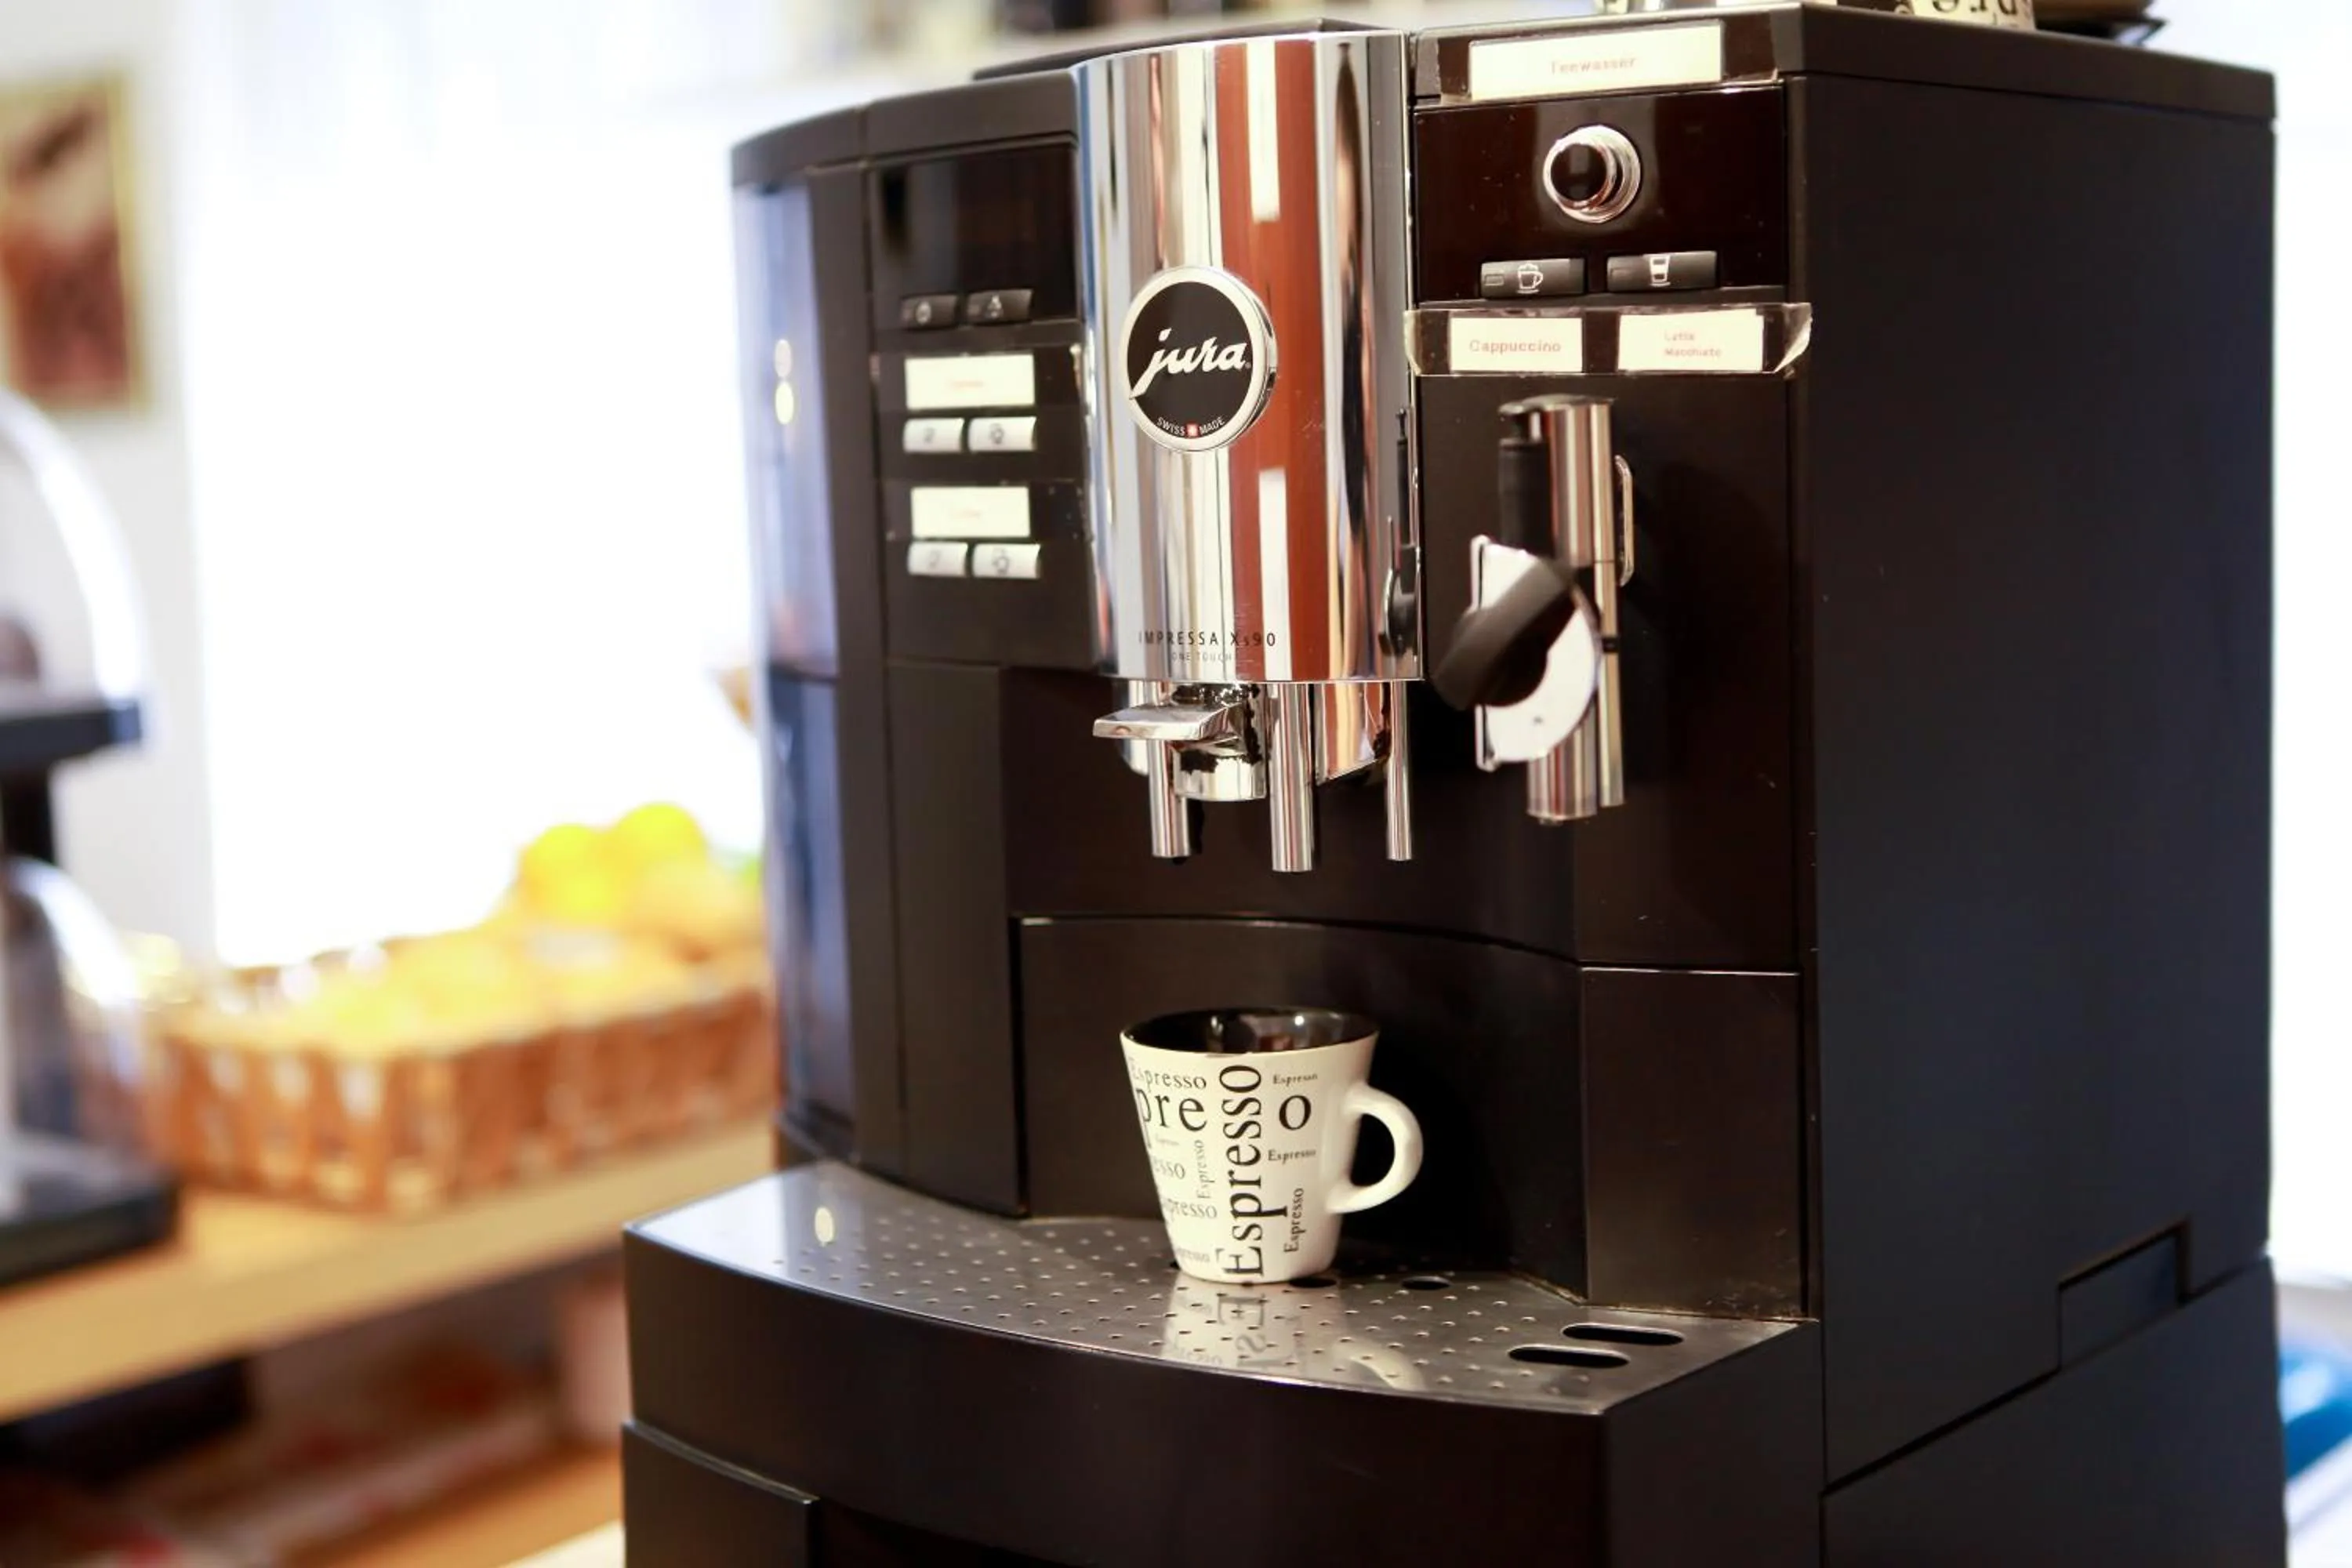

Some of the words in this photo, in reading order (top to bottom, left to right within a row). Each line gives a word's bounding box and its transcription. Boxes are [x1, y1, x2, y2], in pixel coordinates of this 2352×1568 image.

[1552, 57, 1636, 76] Teewasser
[1469, 338, 1562, 356] Cappuccino
[1129, 327, 1248, 401] jura
[1156, 416, 1185, 436] SWISS
[1198, 416, 1225, 435] MADE
[1138, 630, 1219, 647] IMPRESSA
[1219, 1064, 1288, 1277] Espresso
[1283, 1187, 1308, 1254] Espresso
